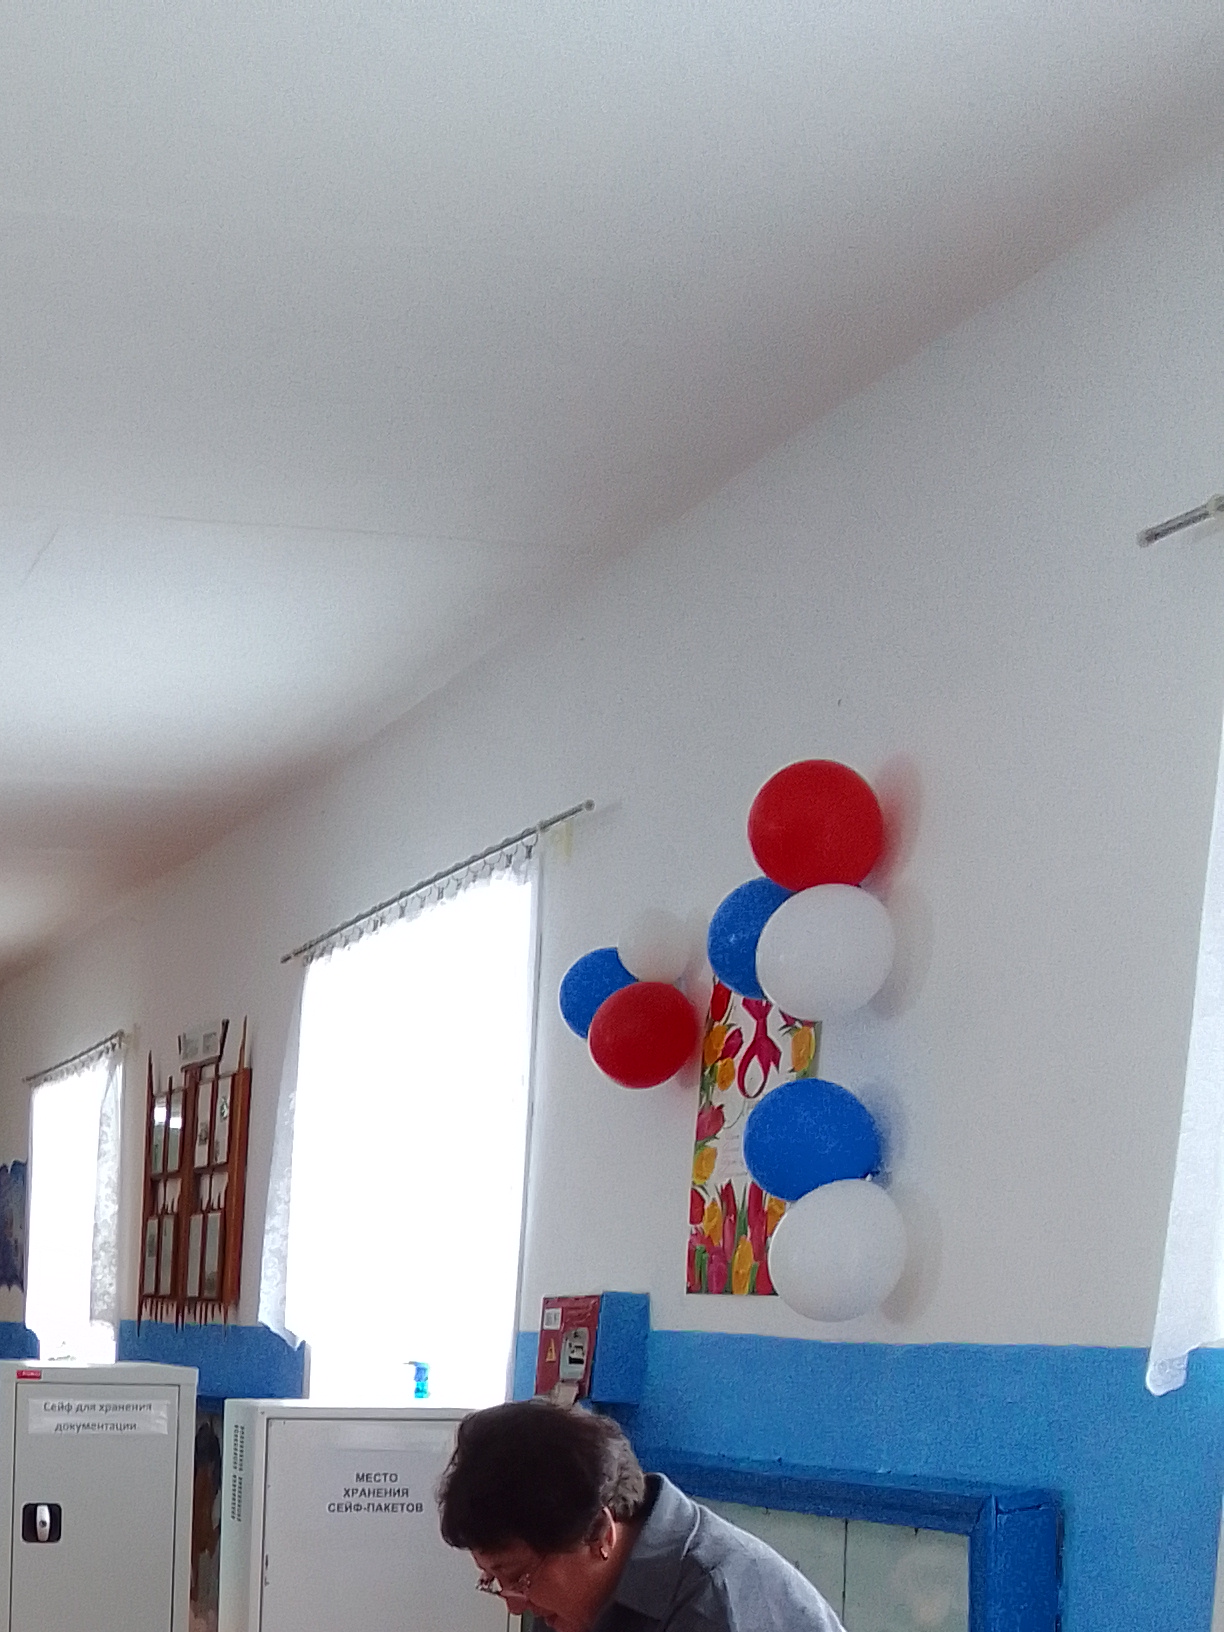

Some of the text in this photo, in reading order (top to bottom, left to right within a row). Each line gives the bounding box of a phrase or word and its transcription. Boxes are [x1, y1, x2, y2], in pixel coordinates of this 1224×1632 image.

[43, 1401, 153, 1415] Сейф для хранения
[54, 1422, 137, 1434] документации
[355, 1472, 399, 1483] МЕСТО
[342, 1487, 410, 1499] ХРАНЕНИЯ
[327, 1501, 424, 1513] СЕЙФ-ПАКЕТОВ
